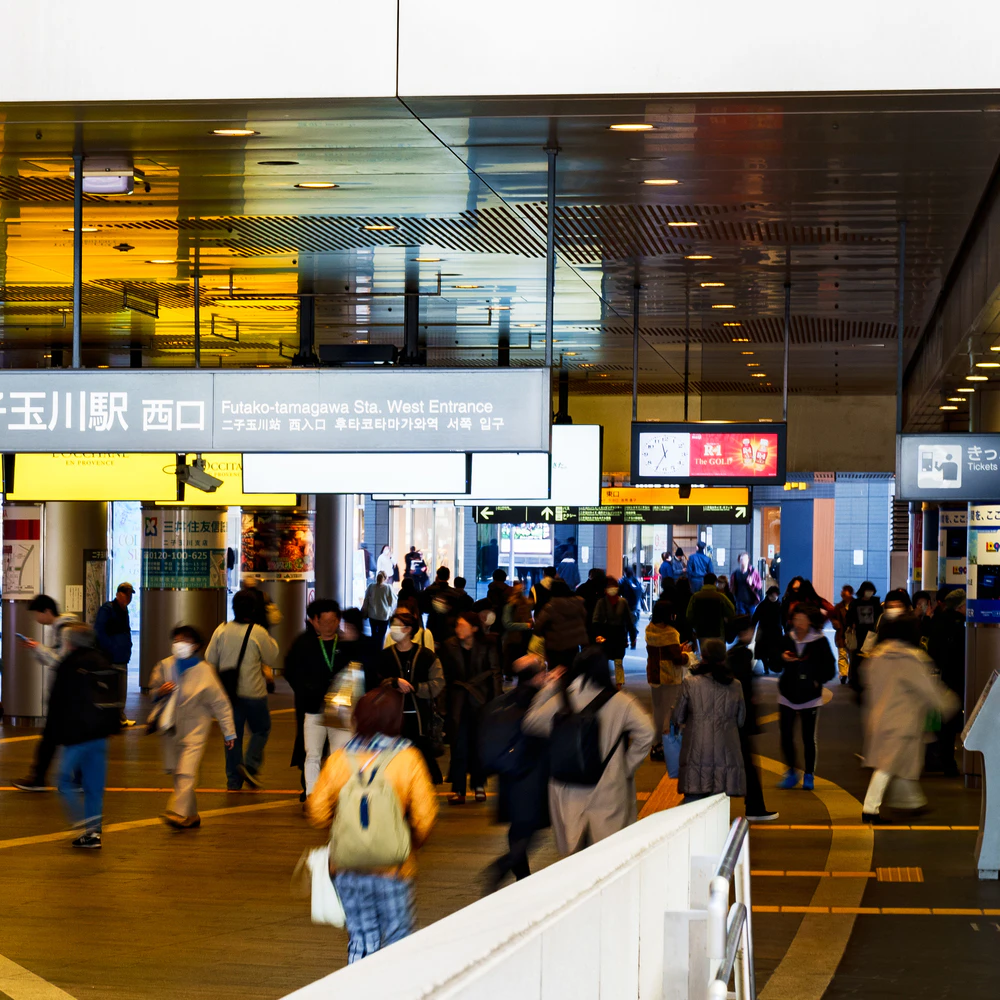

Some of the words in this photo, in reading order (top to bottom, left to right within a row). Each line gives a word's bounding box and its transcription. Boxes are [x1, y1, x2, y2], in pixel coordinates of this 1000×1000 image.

[221, 400, 349, 415] Futako-tamagawa
[354, 400, 383, 414] Sta.
[387, 400, 425, 414] West
[429, 400, 493, 414] Entrance
[142, 400, 205, 431] 西口
[222, 418, 281, 431] 二子玉川站
[289, 418, 326, 431] 西入口
[334, 418, 439, 431] 후타코타마가와역
[447, 418, 471, 431] 서쪽
[480, 418, 505, 431] 입구
[968, 445, 1000, 461] きっ
[968, 462, 998, 471] Tickets
